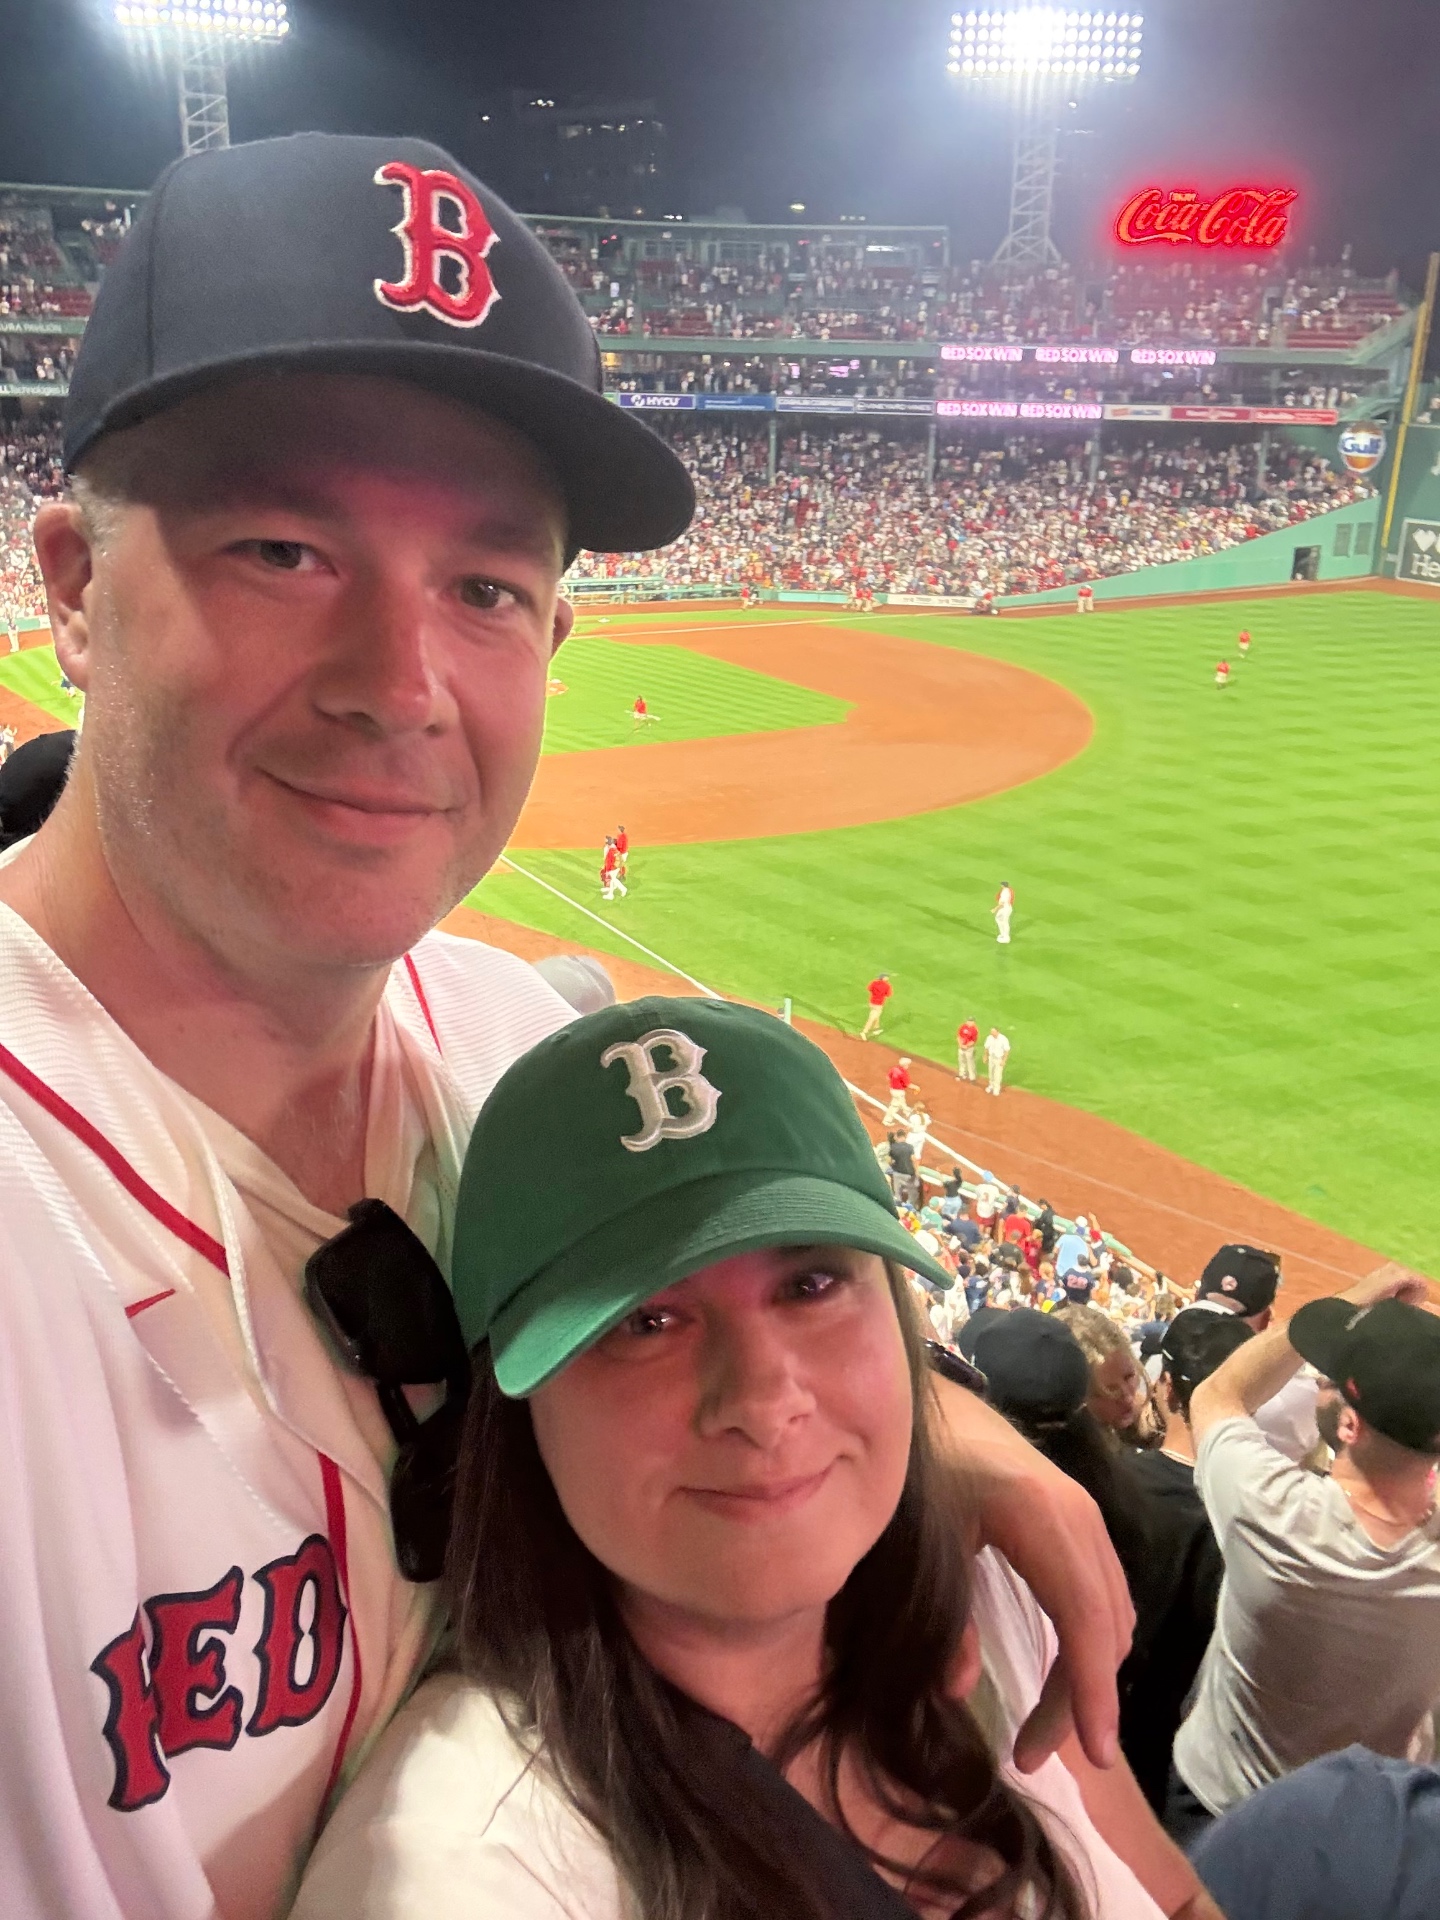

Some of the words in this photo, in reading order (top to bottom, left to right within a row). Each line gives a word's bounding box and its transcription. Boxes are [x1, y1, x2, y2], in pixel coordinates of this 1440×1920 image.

[1116, 188, 1298, 245] Coca-Cola
[373, 161, 502, 328] B
[941, 346, 965, 360] RED
[965, 346, 992, 361] SOX
[993, 347, 1023, 361] WIN
[1035, 347, 1060, 362] RED
[1060, 347, 1087, 362] SOX
[1088, 348, 1119, 363] WIN
[1131, 349, 1156, 363] RED
[1157, 350, 1184, 364] SOX
[1185, 350, 1216, 365] WIN
[645, 397, 680, 407] HYCU
[937, 402, 961, 416] RED
[961, 402, 988, 416] SOX
[988, 403, 1018, 417] WIN
[1020, 403, 1045, 417] RED
[1045, 403, 1071, 418] SOX
[1071, 404, 1102, 418] WIN
[1342, 435, 1381, 455] Gulf
[600, 1028, 723, 1152] B
